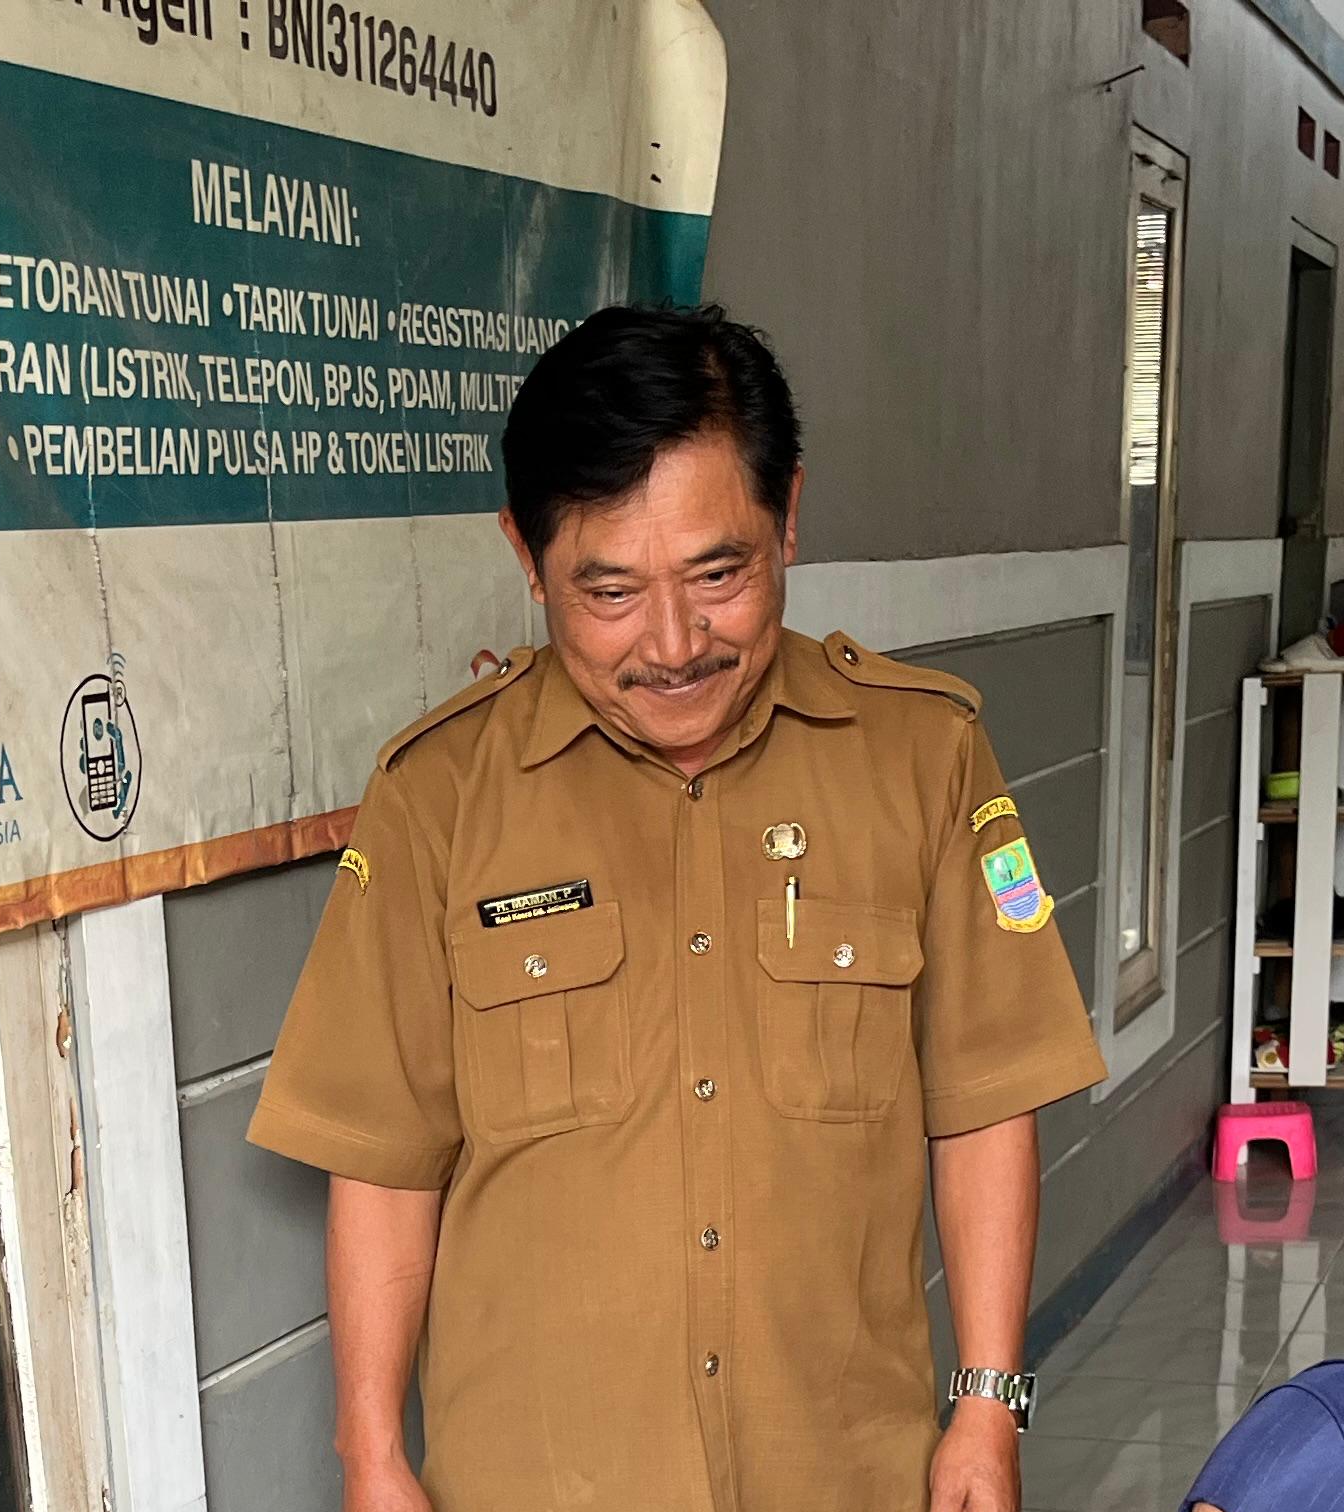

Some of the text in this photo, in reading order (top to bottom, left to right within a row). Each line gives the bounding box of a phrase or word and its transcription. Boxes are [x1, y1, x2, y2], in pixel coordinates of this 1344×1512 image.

[268, 0, 498, 118] BNI311264440
[191, 158, 362, 249] MELAYANI:
[233, 283, 308, 333] TARIK
[308, 293, 379, 343] TUNAI
[399, 302, 510, 353] REGISTRASI
[81, 342, 201, 408] (LISTRIK,
[201, 354, 320, 414] TELEPON,
[325, 362, 384, 413] BPJS,
[388, 368, 456, 416] PDAM,
[23, 425, 493, 477] PEMBELIAN PULSA HP & TOKEN LISTRIK
